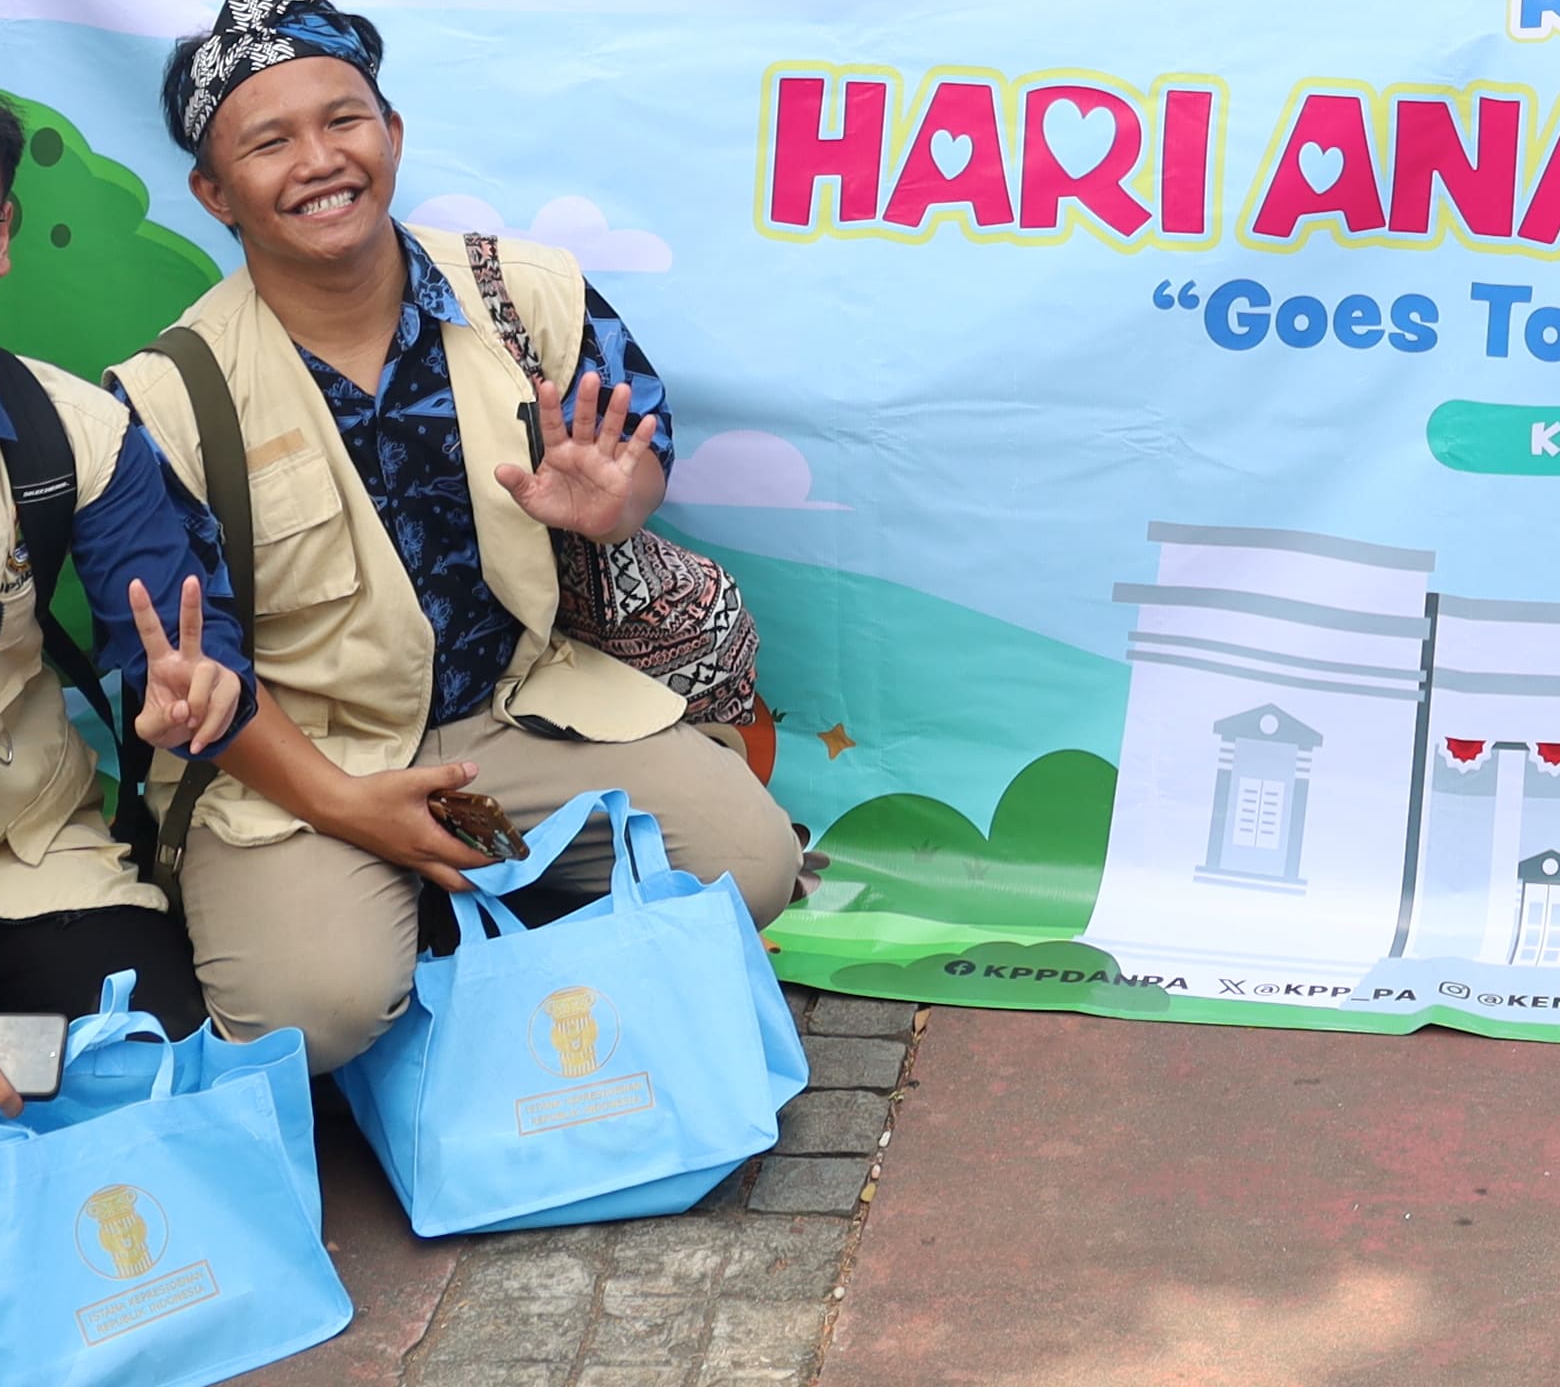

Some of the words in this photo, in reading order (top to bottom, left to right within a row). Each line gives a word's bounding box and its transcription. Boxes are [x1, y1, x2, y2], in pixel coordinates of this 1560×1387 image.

[769, 76, 1214, 238] HARI
[981, 962, 1190, 992] KPPDANPA
[1252, 980, 1418, 1005] @KPP_PA
